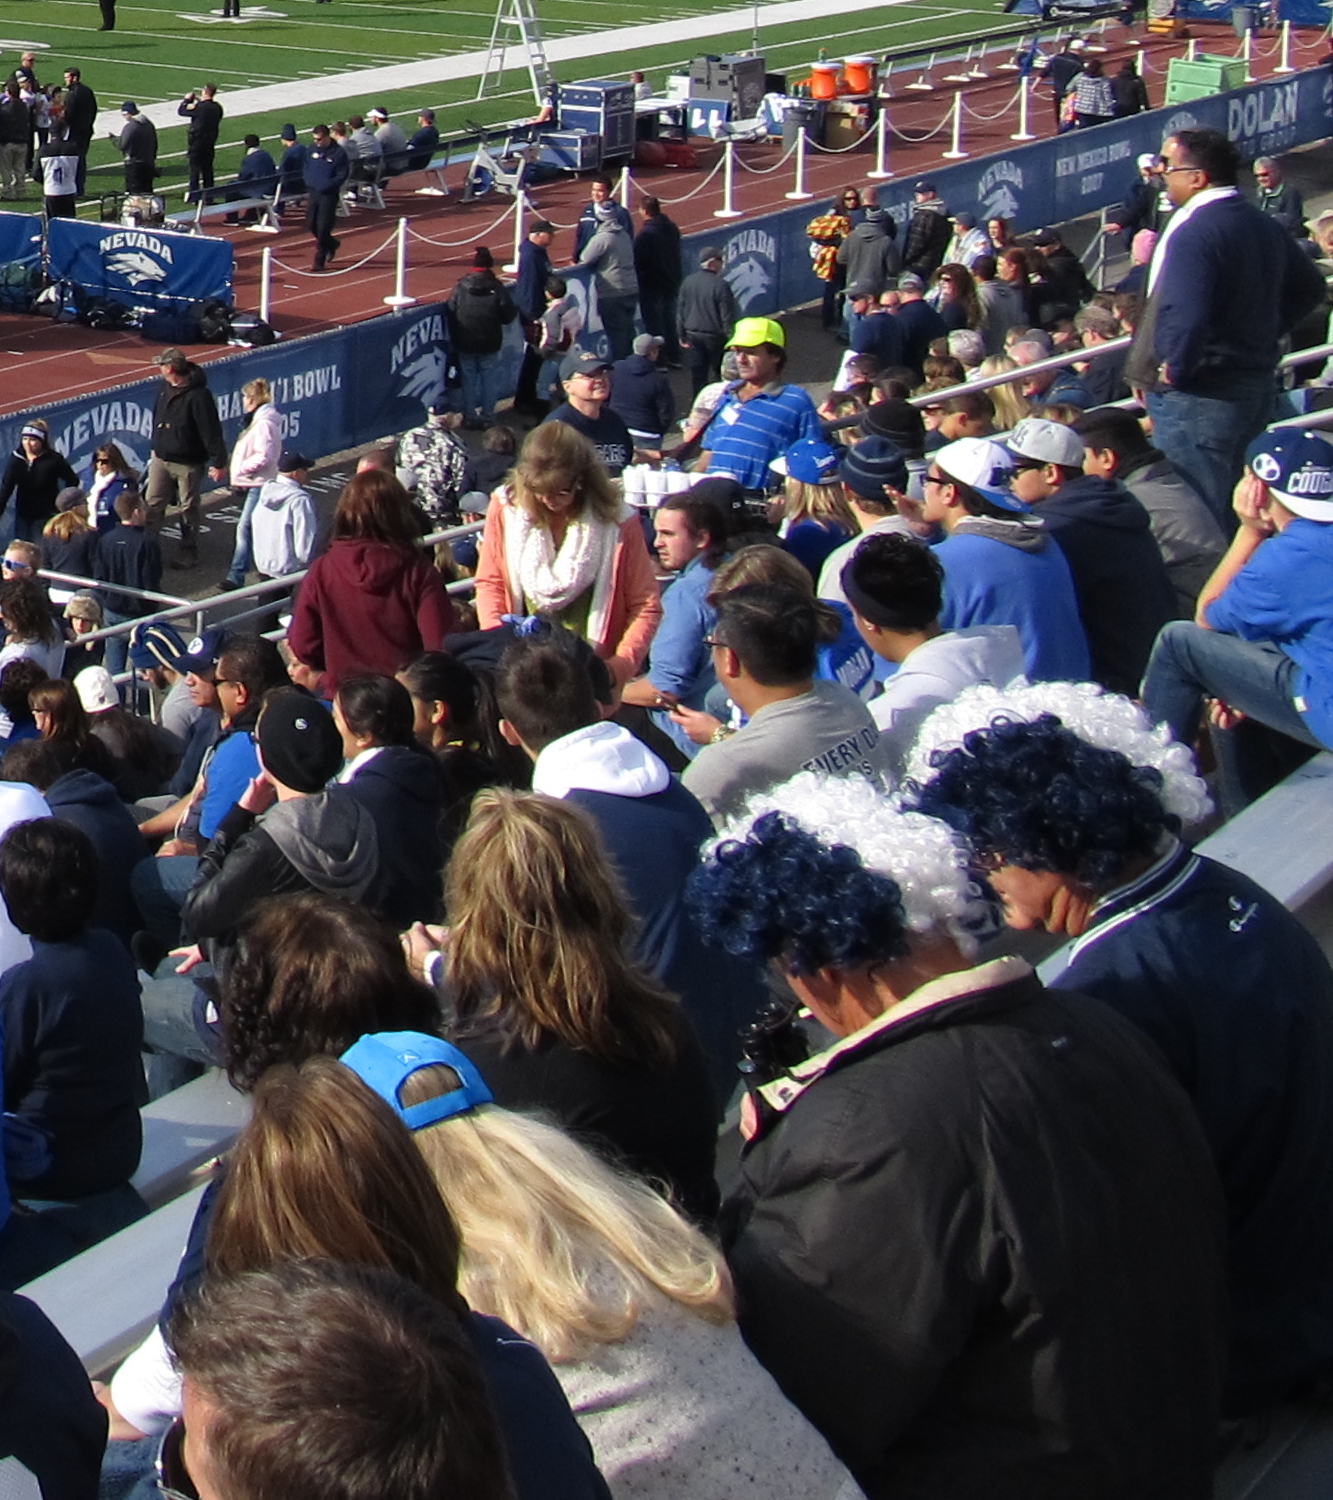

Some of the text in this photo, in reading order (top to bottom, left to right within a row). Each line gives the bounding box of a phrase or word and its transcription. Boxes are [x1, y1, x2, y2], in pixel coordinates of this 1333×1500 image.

[1227, 80, 1301, 142] DOLAN
[977, 160, 1025, 200] NEVADA
[1055, 156, 1075, 178] NEW
[98, 231, 174, 265] NEVADA
[722, 229, 776, 265] EVADA
[390, 314, 450, 375] NEVA
[216, 363, 341, 422] HAI'I BOWL
[54, 399, 154, 460] NEVADA
[802, 735, 862, 776] EVERY
